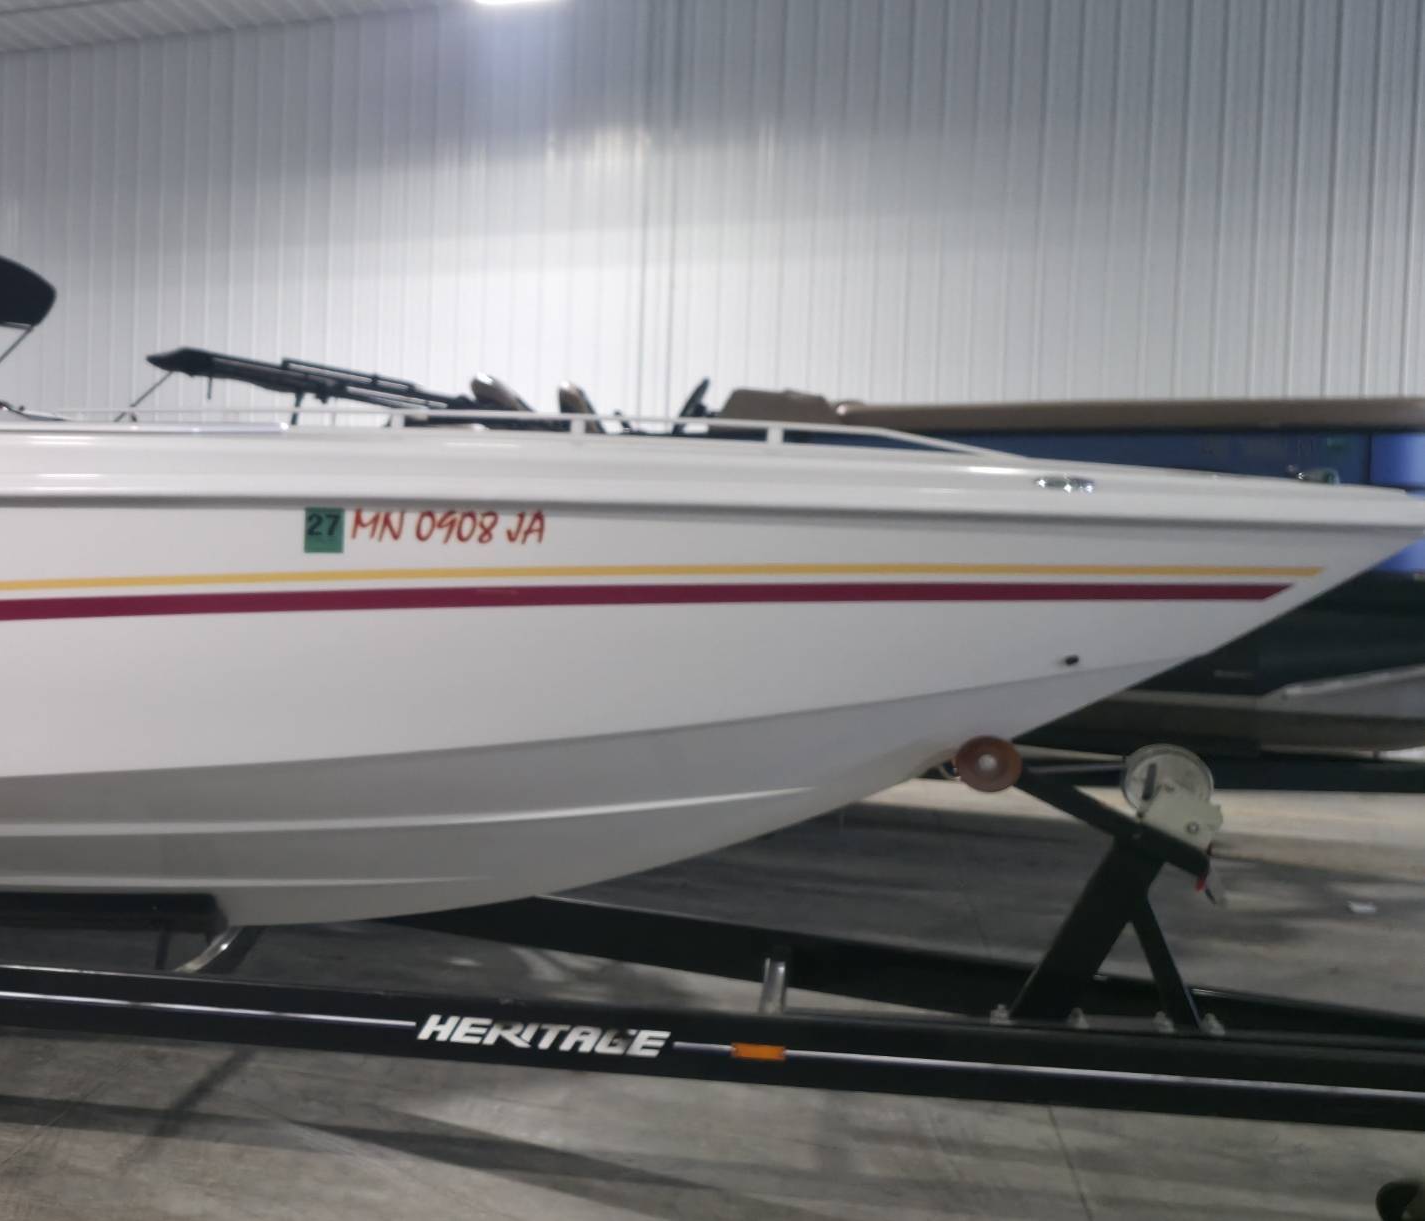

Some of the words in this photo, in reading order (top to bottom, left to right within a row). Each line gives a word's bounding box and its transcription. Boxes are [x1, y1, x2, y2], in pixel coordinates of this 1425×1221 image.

[307, 514, 341, 537] 27
[351, 508, 405, 542] MN
[415, 510, 498, 544] 0908
[506, 509, 545, 544] JA
[417, 1014, 671, 1058] HERITAGE
